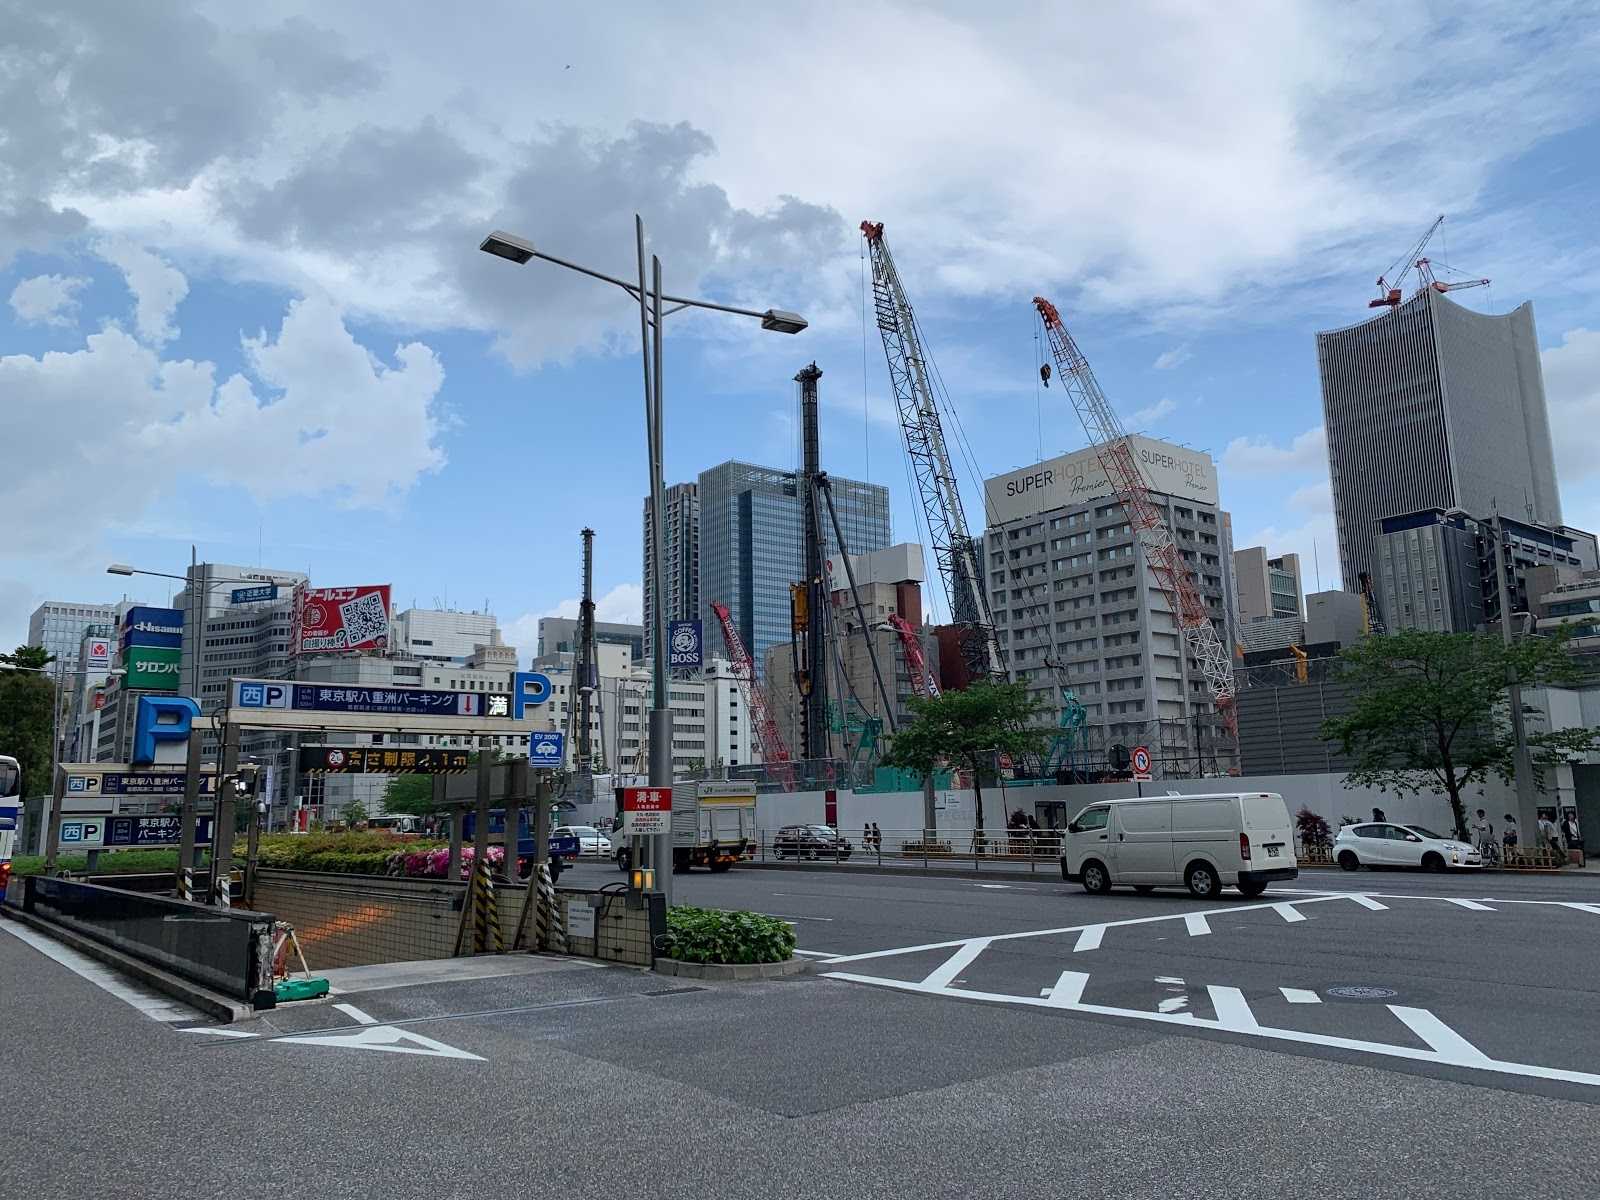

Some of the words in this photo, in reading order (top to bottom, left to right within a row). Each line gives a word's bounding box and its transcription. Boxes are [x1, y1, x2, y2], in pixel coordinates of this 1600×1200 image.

[1071, 475, 1109, 497] Premier
[673, 627, 696, 636] COFFEE
[671, 652, 699, 663] BOSS
[319, 688, 455, 707] 東京駅八重洲パーキング
[488, 695, 508, 716] 満
[512, 671, 552, 721] P
[134, 694, 200, 765] P
